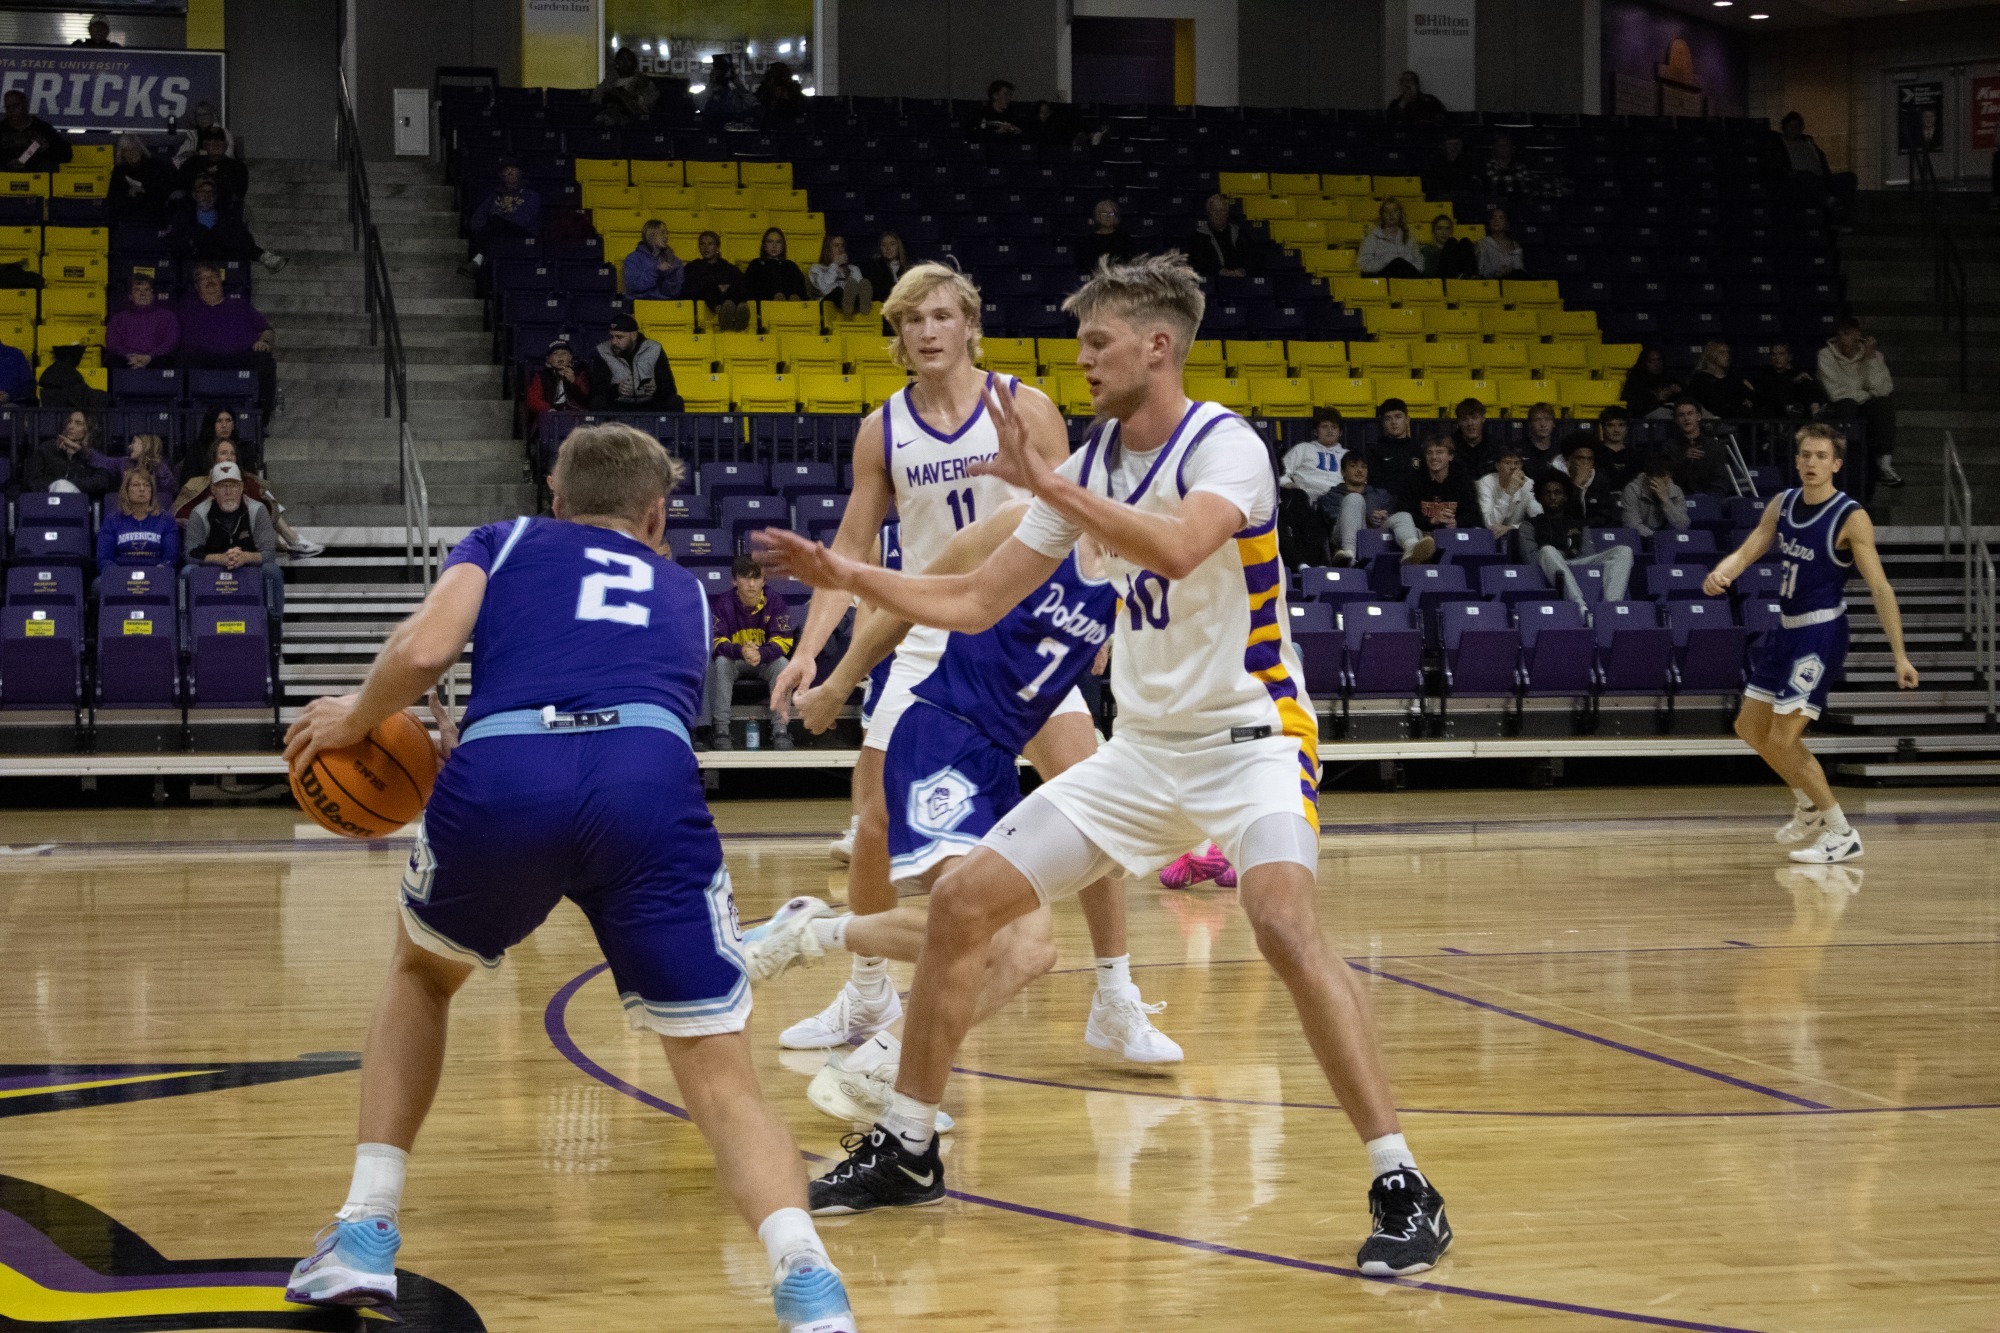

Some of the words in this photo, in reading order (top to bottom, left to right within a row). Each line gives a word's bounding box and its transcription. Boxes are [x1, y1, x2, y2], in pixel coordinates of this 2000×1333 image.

[529, 2, 570, 11] Garden
[571, 3, 590, 12] Inn
[1427, 14, 1469, 26] Hilton
[1452, 28, 1469, 36] Inn
[20, 60, 56, 69] STATE
[60, 61, 131, 71] UNIVERSITY
[946, 487, 976, 532] 11
[117, 531, 162, 545] MAVERICKS
[575, 548, 654, 628] 2
[1126, 569, 1171, 632] 10
[1032, 582, 1107, 645] Polars
[1016, 636, 1070, 702] 7
[299, 764, 374, 836] Wilson
